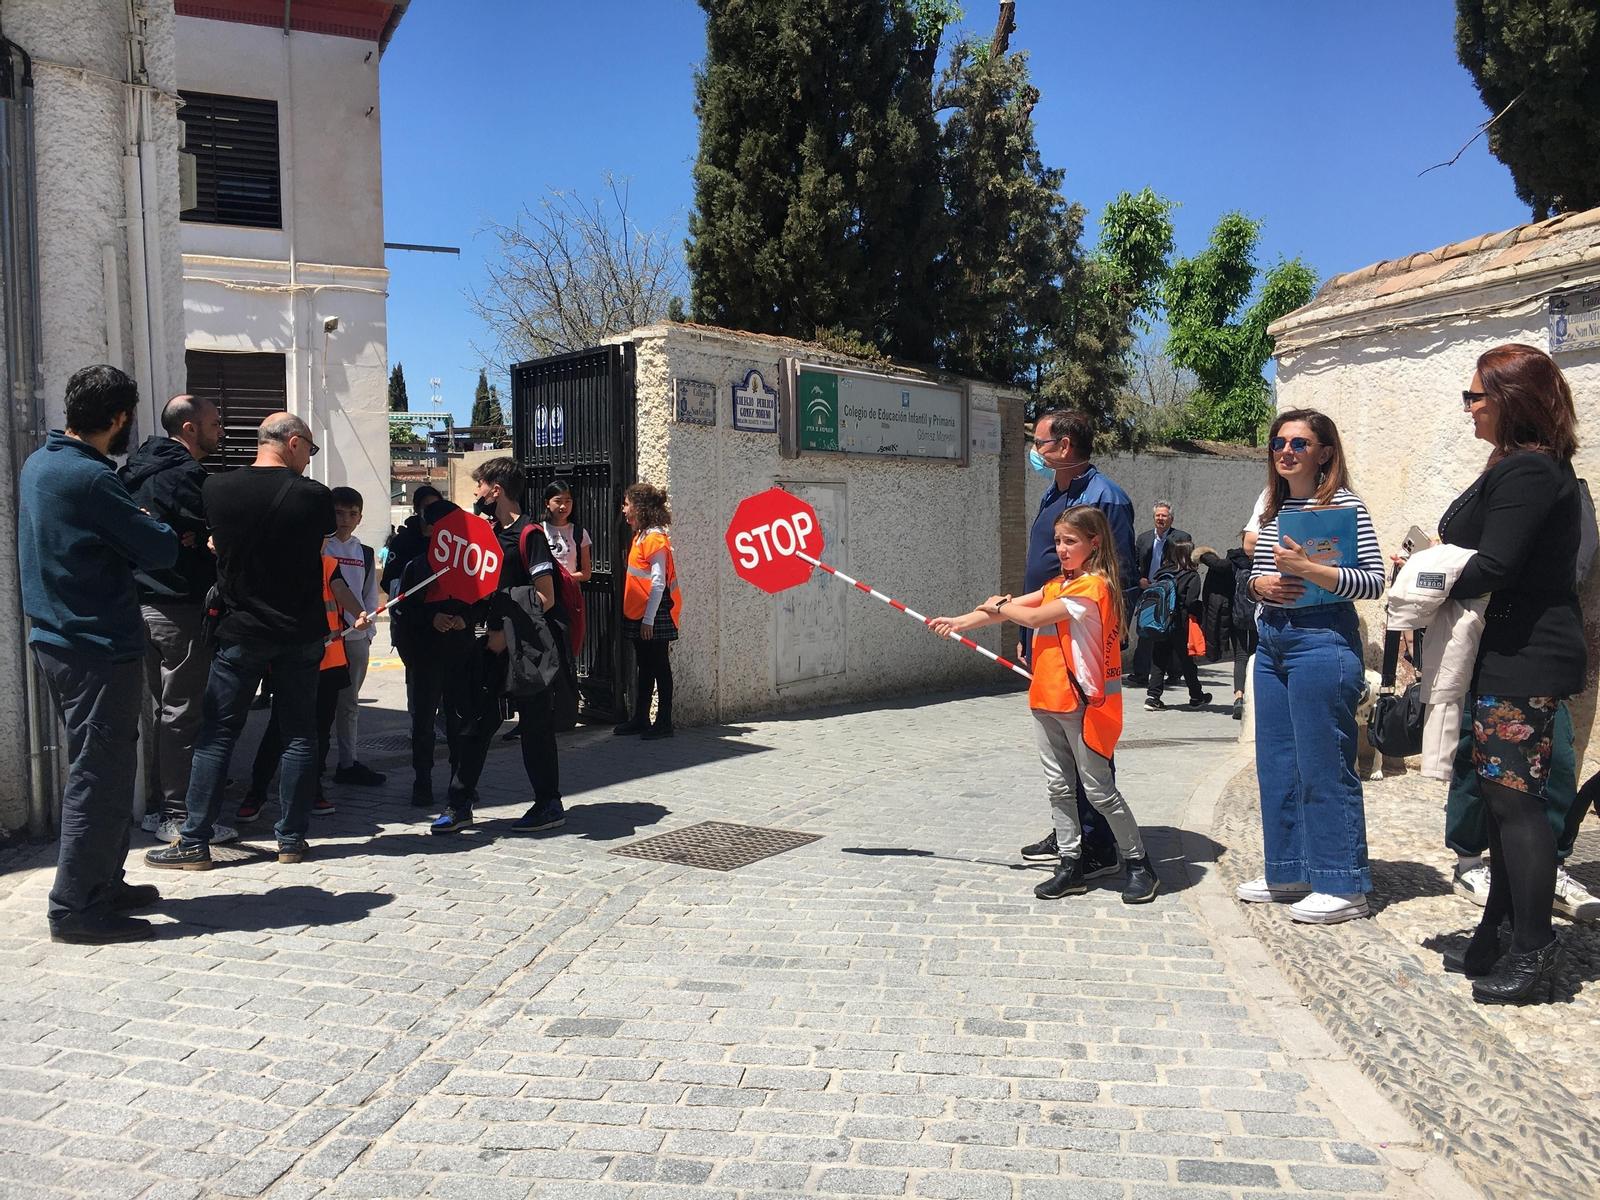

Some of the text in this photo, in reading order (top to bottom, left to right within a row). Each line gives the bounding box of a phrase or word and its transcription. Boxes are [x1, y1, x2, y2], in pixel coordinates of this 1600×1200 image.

[1575, 325, 1588, 338] San
[736, 396, 754, 407] COLEGIO
[844, 404, 955, 428] Colegio de Educación Infantil y Primaria
[936, 430, 955, 443] Moreno
[735, 511, 813, 569] STOP
[434, 529, 498, 581] STOP
